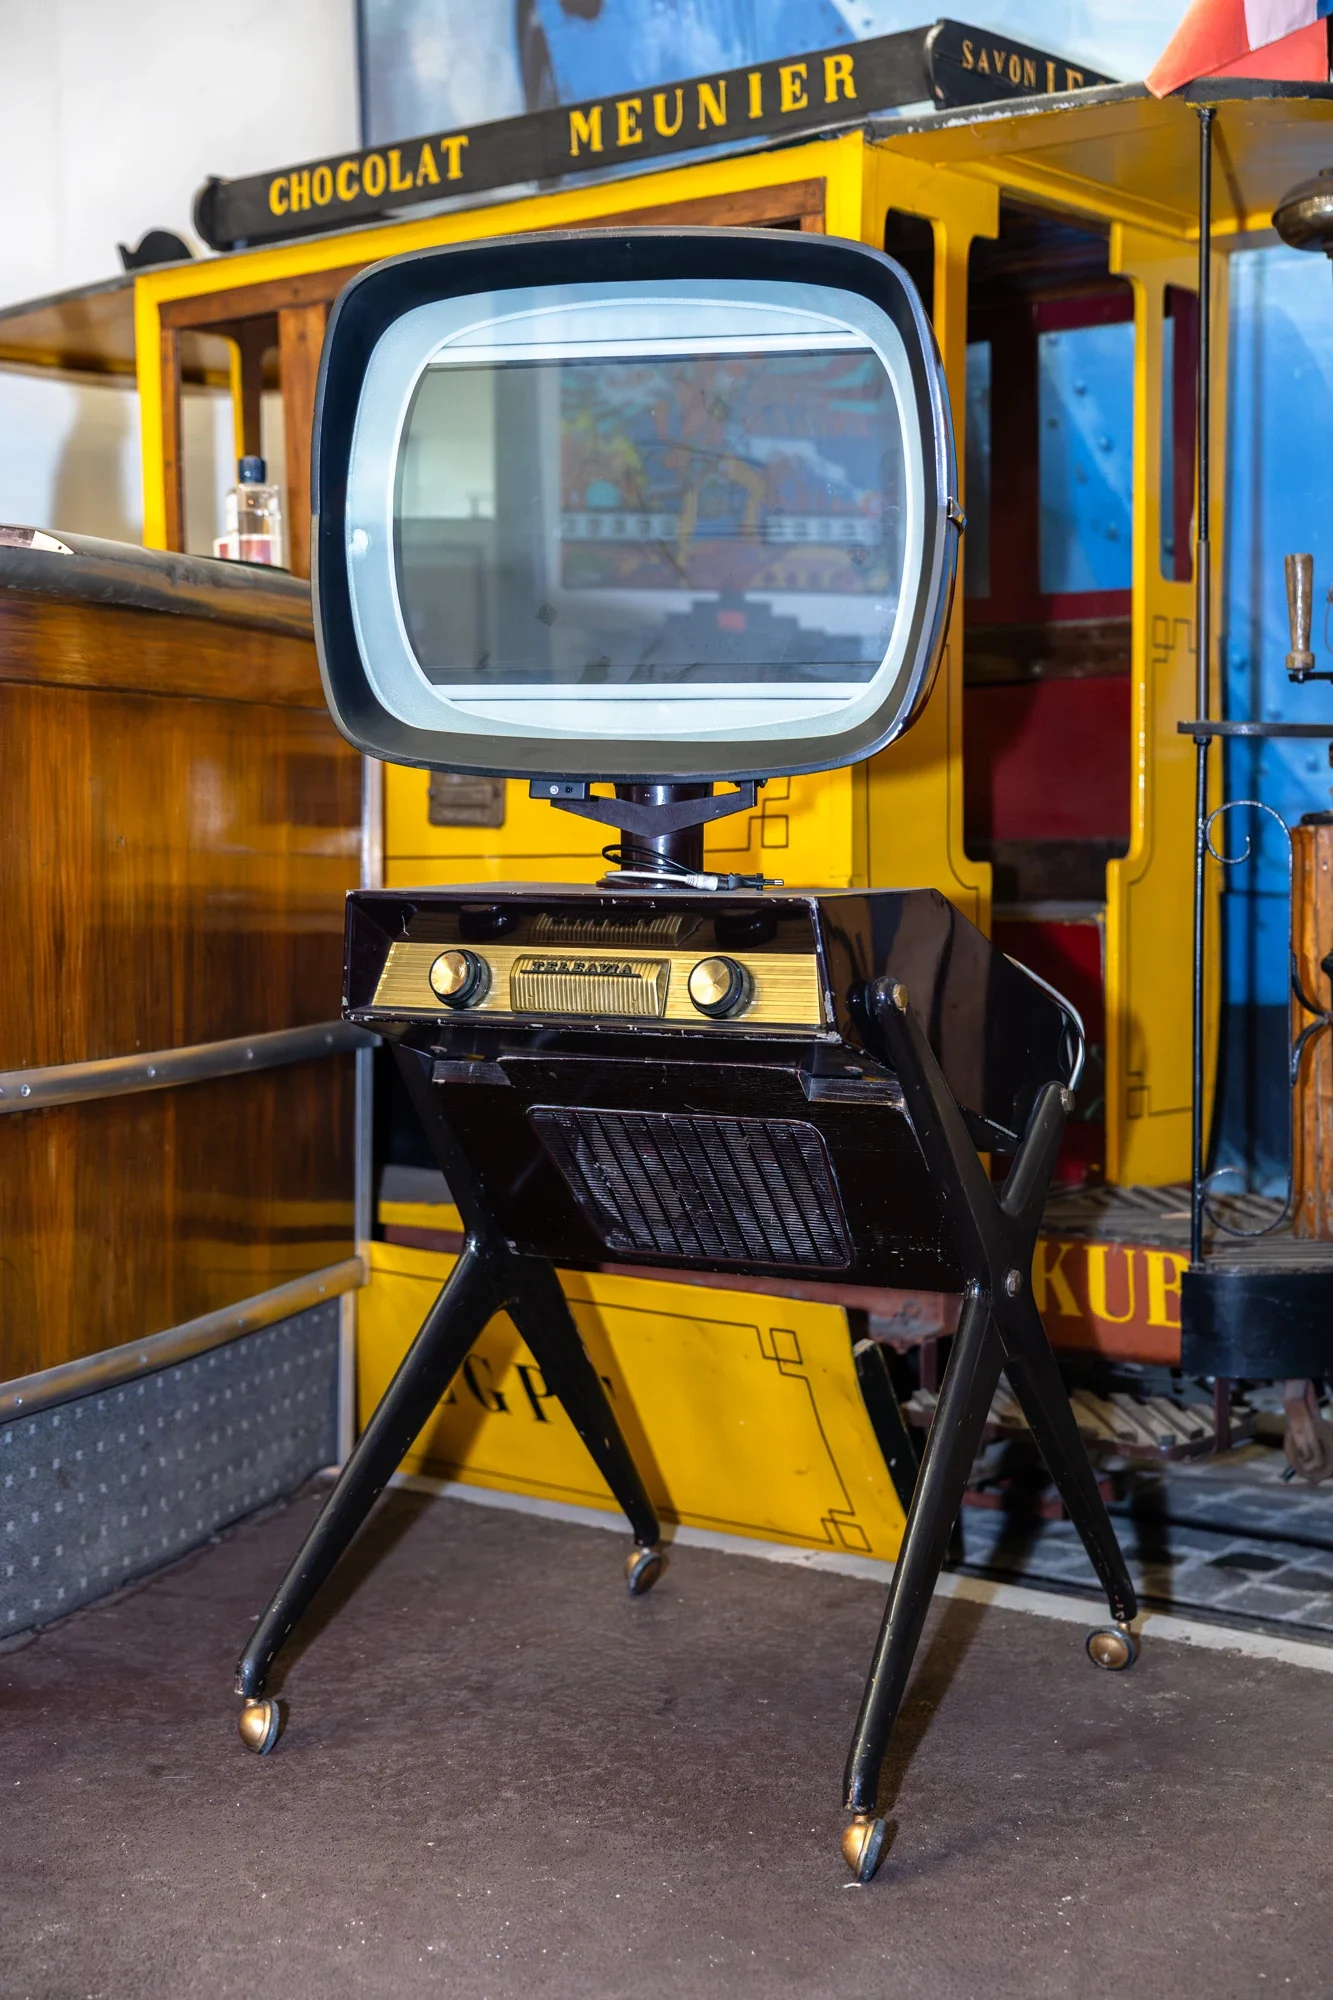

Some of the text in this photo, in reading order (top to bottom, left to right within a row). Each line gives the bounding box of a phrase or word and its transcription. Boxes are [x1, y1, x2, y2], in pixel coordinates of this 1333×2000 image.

[961, 39, 1037, 88] SAVON
[268, 53, 858, 217] CHOCOLAT MEUNIER
[1032, 1240, 1190, 1329] KUB
